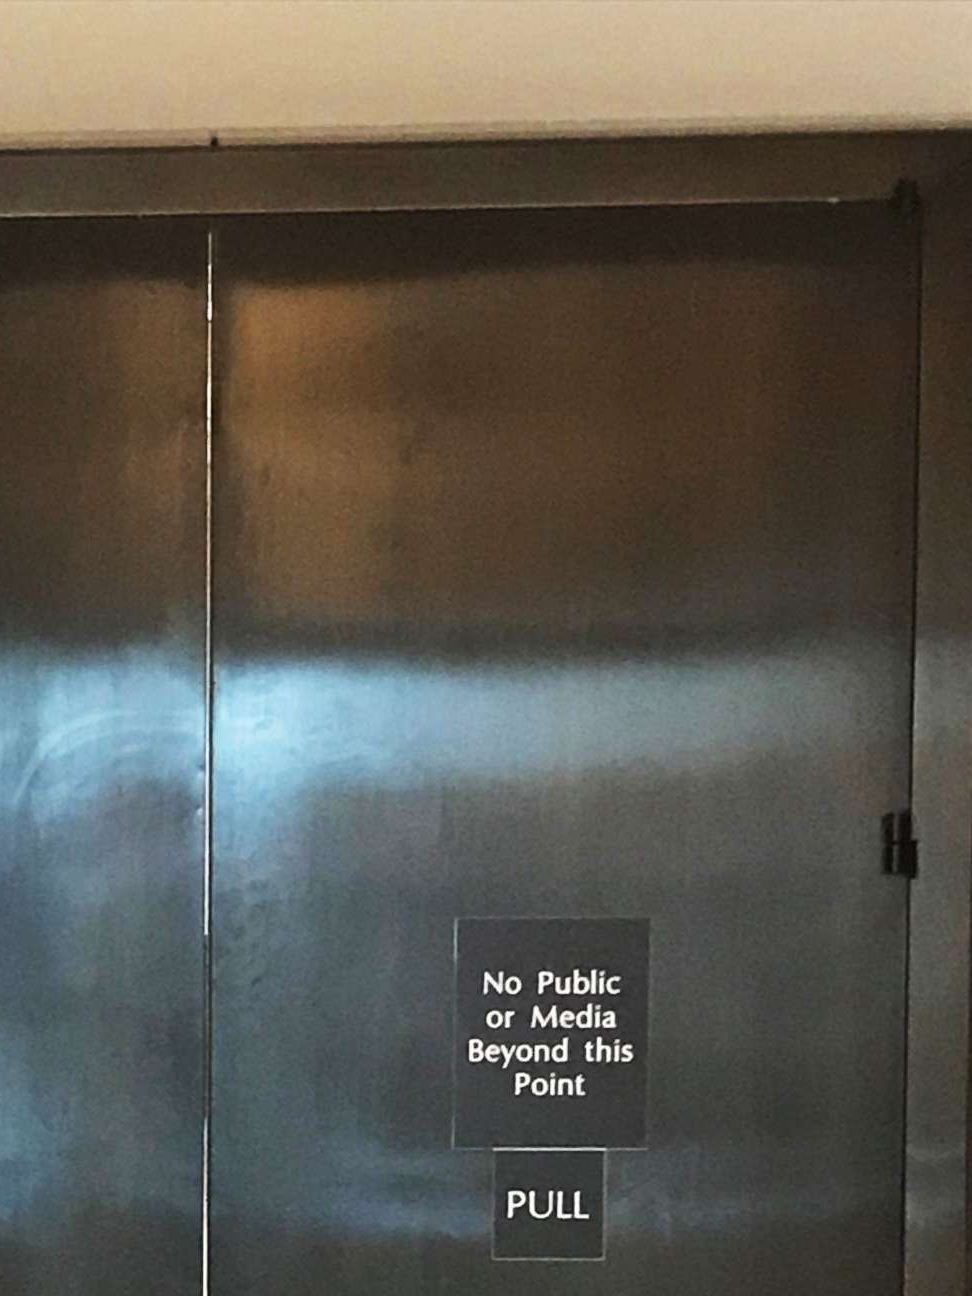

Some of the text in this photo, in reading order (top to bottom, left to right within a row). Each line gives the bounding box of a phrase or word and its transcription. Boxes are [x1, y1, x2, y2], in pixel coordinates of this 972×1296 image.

[482, 968, 622, 996] No Public
[485, 1002, 618, 1029] or Media
[468, 1036, 634, 1069] Beyond this
[514, 1071, 586, 1097] Point
[506, 1189, 590, 1220] PULL
